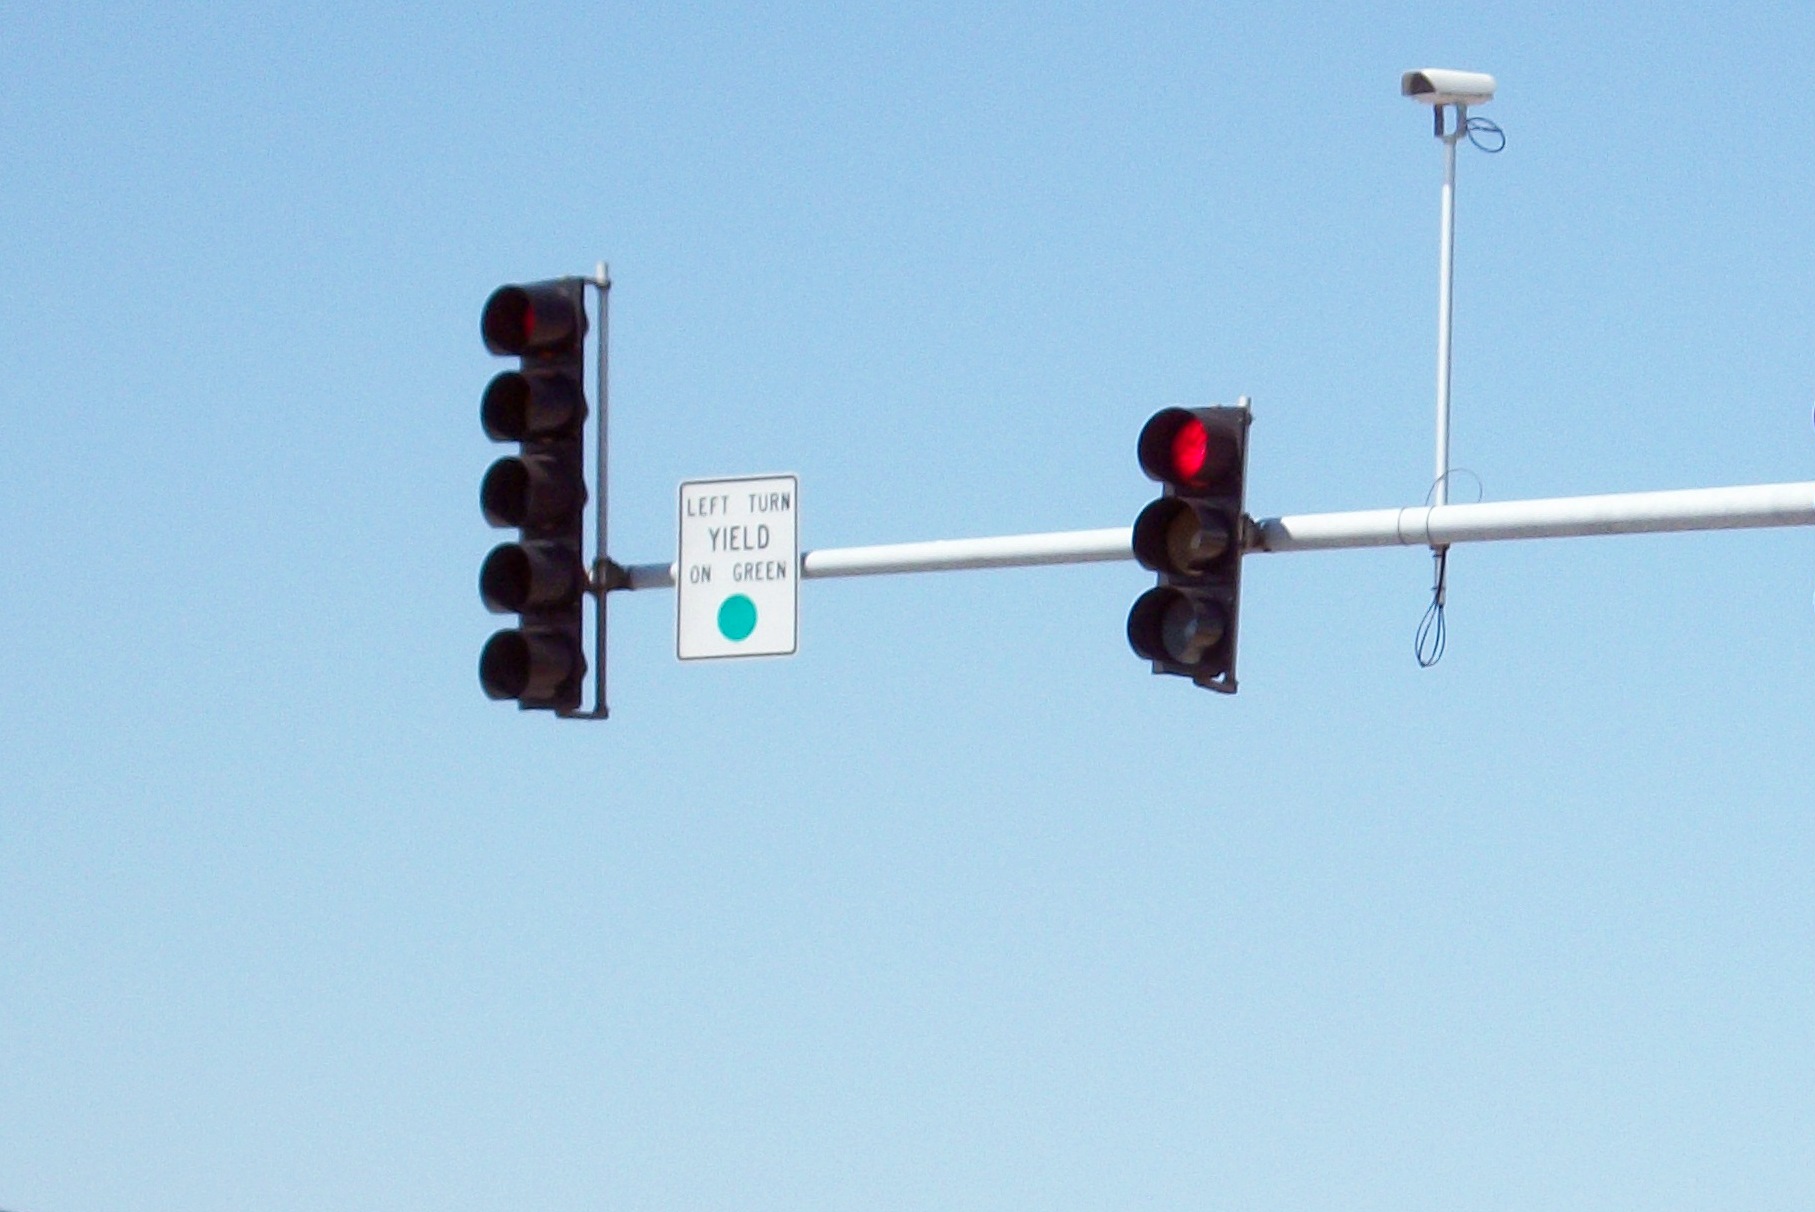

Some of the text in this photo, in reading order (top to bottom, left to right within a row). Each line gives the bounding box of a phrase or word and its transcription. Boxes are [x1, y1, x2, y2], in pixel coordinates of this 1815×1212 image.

[687, 491, 790, 517] LEFT TURN
[708, 524, 770, 552] YIELD
[690, 561, 787, 584] ON GREEN
